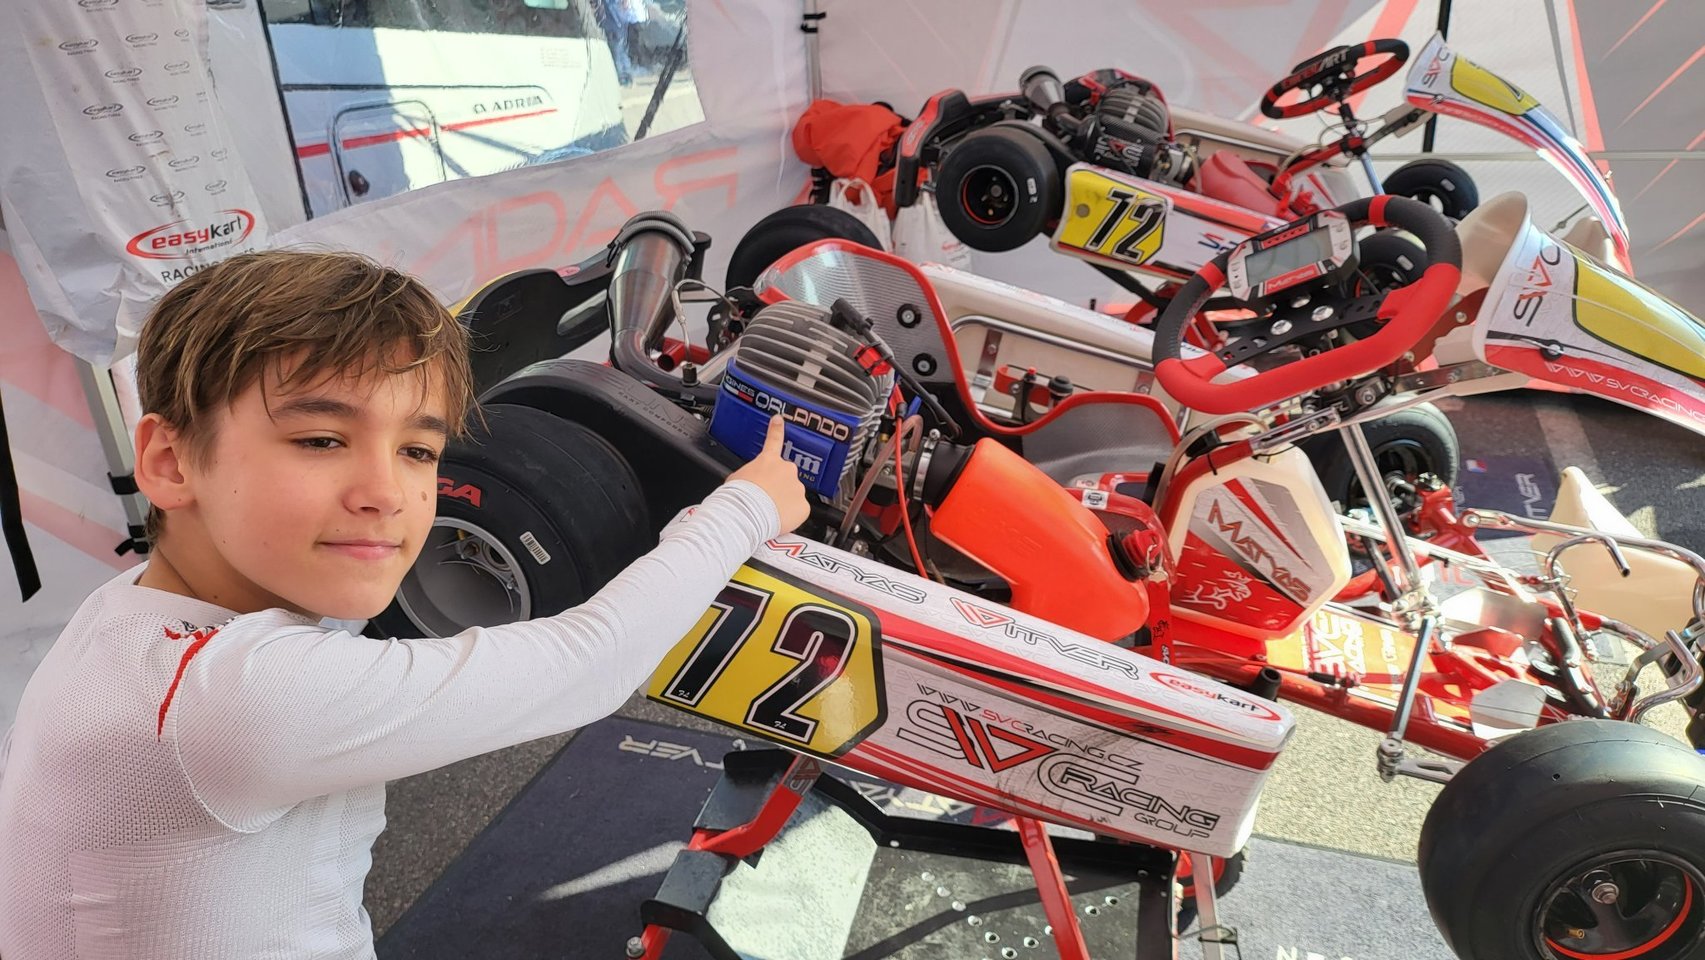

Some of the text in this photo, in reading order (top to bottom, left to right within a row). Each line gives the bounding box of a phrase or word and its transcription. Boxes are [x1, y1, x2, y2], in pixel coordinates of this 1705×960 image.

[151, 215, 242, 250] easykart
[756, 391, 849, 442] ORLANDO
[765, 539, 928, 603] MATYAS
[1208, 499, 1312, 602] MATYAS
[1169, 679, 1260, 712] easykart
[1060, 767, 1220, 831] RACING
[1133, 812, 1211, 839] GROUP
